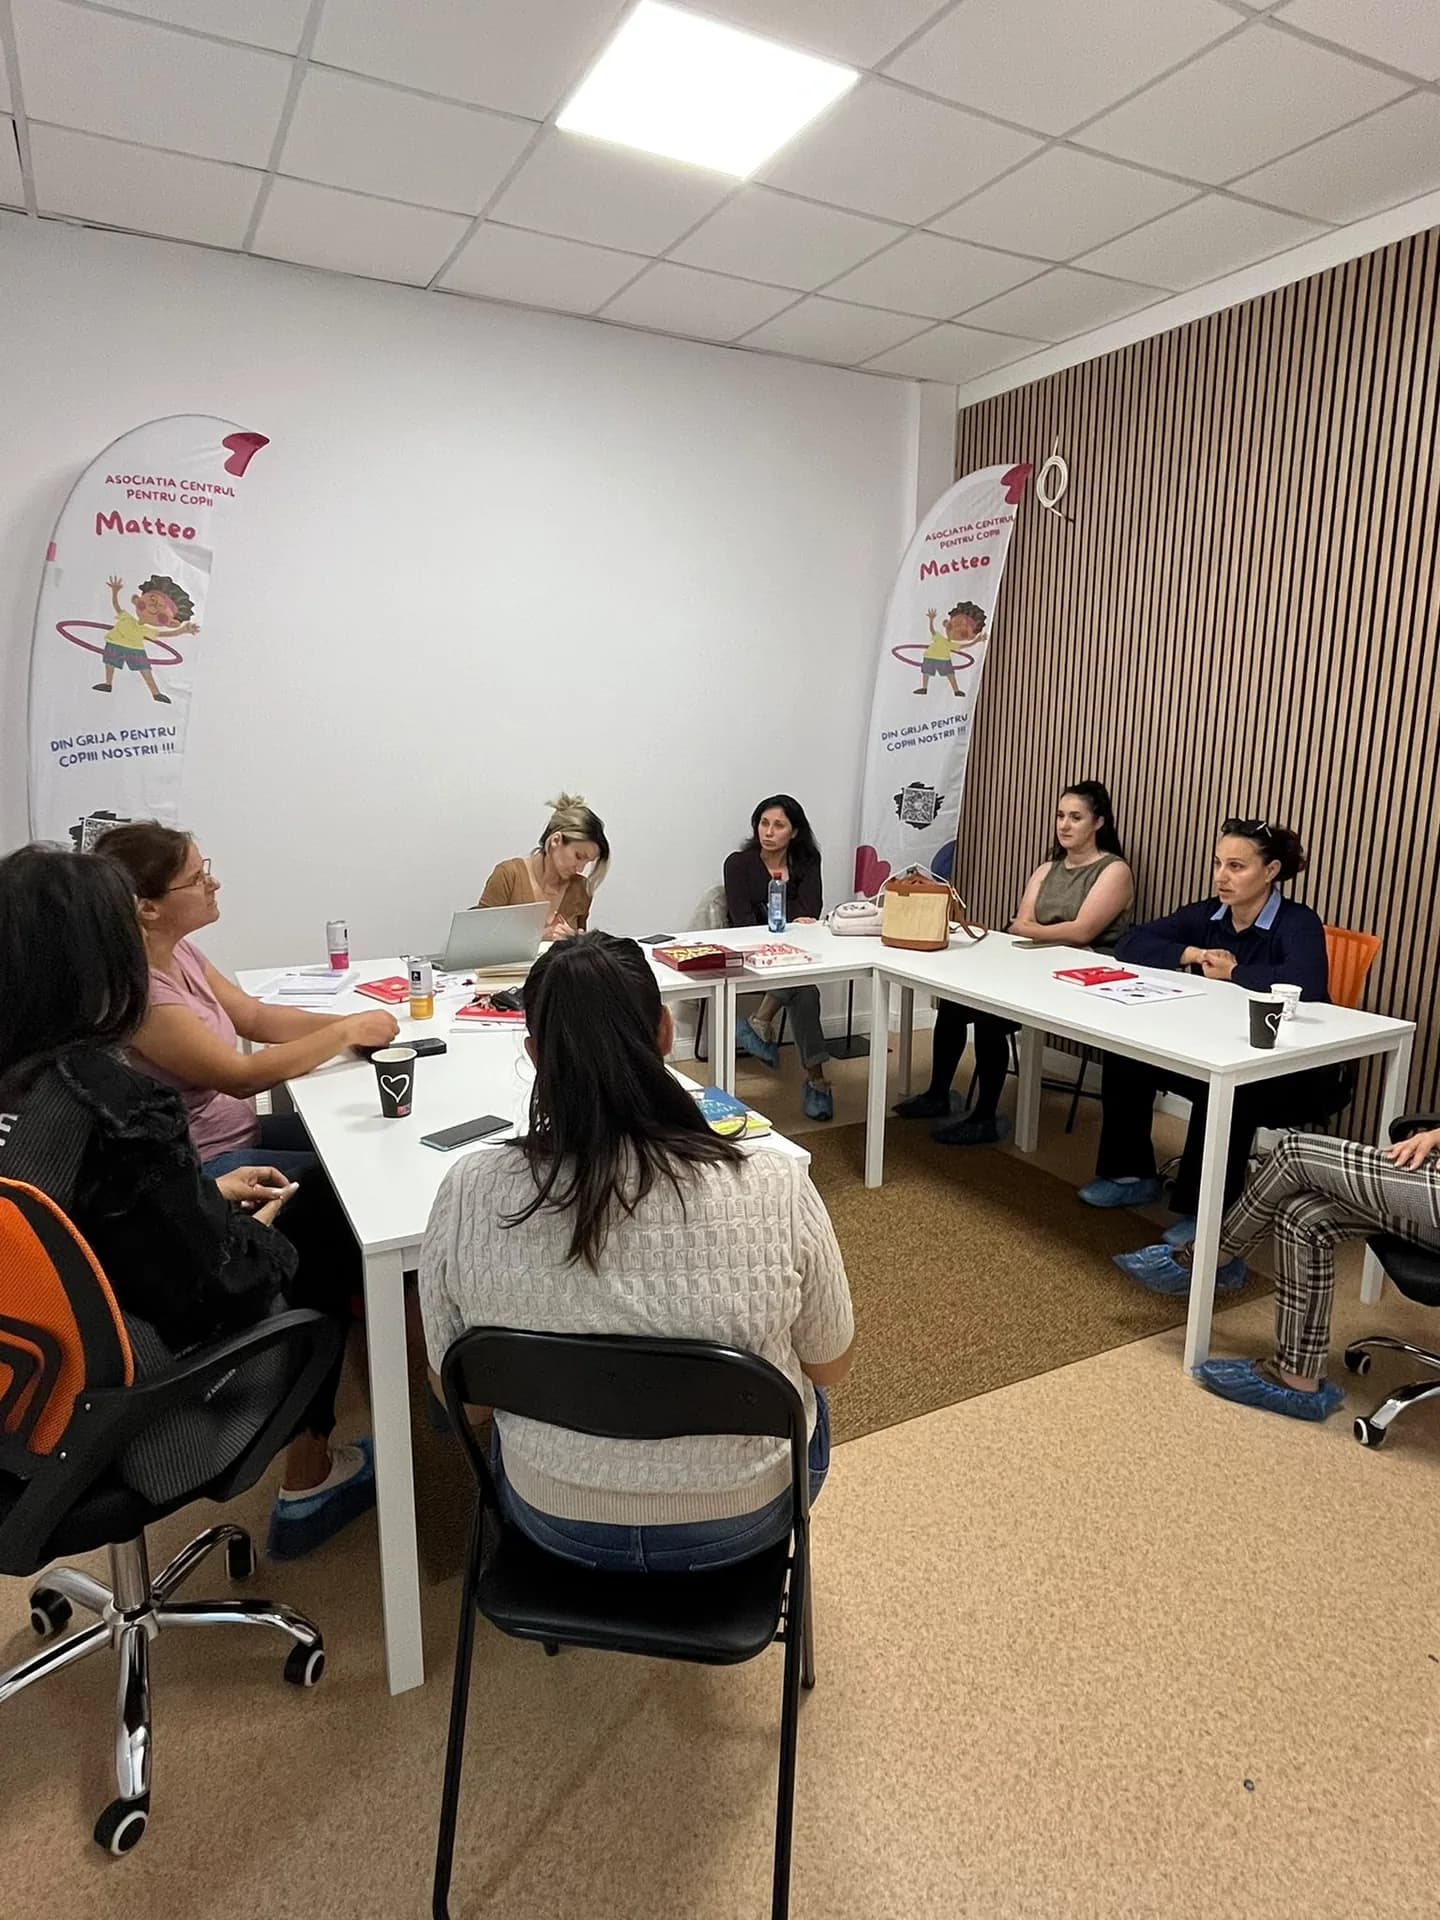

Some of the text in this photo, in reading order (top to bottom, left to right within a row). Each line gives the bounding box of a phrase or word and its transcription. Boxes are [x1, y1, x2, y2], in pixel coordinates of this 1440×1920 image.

[105, 475, 235, 497] ASOCIATIA CENTRUL
[126, 489, 213, 507] PENTRU COPII
[96, 510, 196, 539] Matteo
[925, 524, 974, 542] ASOCIATIA
[940, 535, 975, 549] PENTRU
[919, 556, 990, 581] Matteo
[880, 713, 968, 741] DIN GRIJA PENTRU
[50, 726, 176, 752] DIN GRIJA PENTRU
[59, 752, 98, 767] COPIII
[102, 745, 158, 760] NOSTRII
